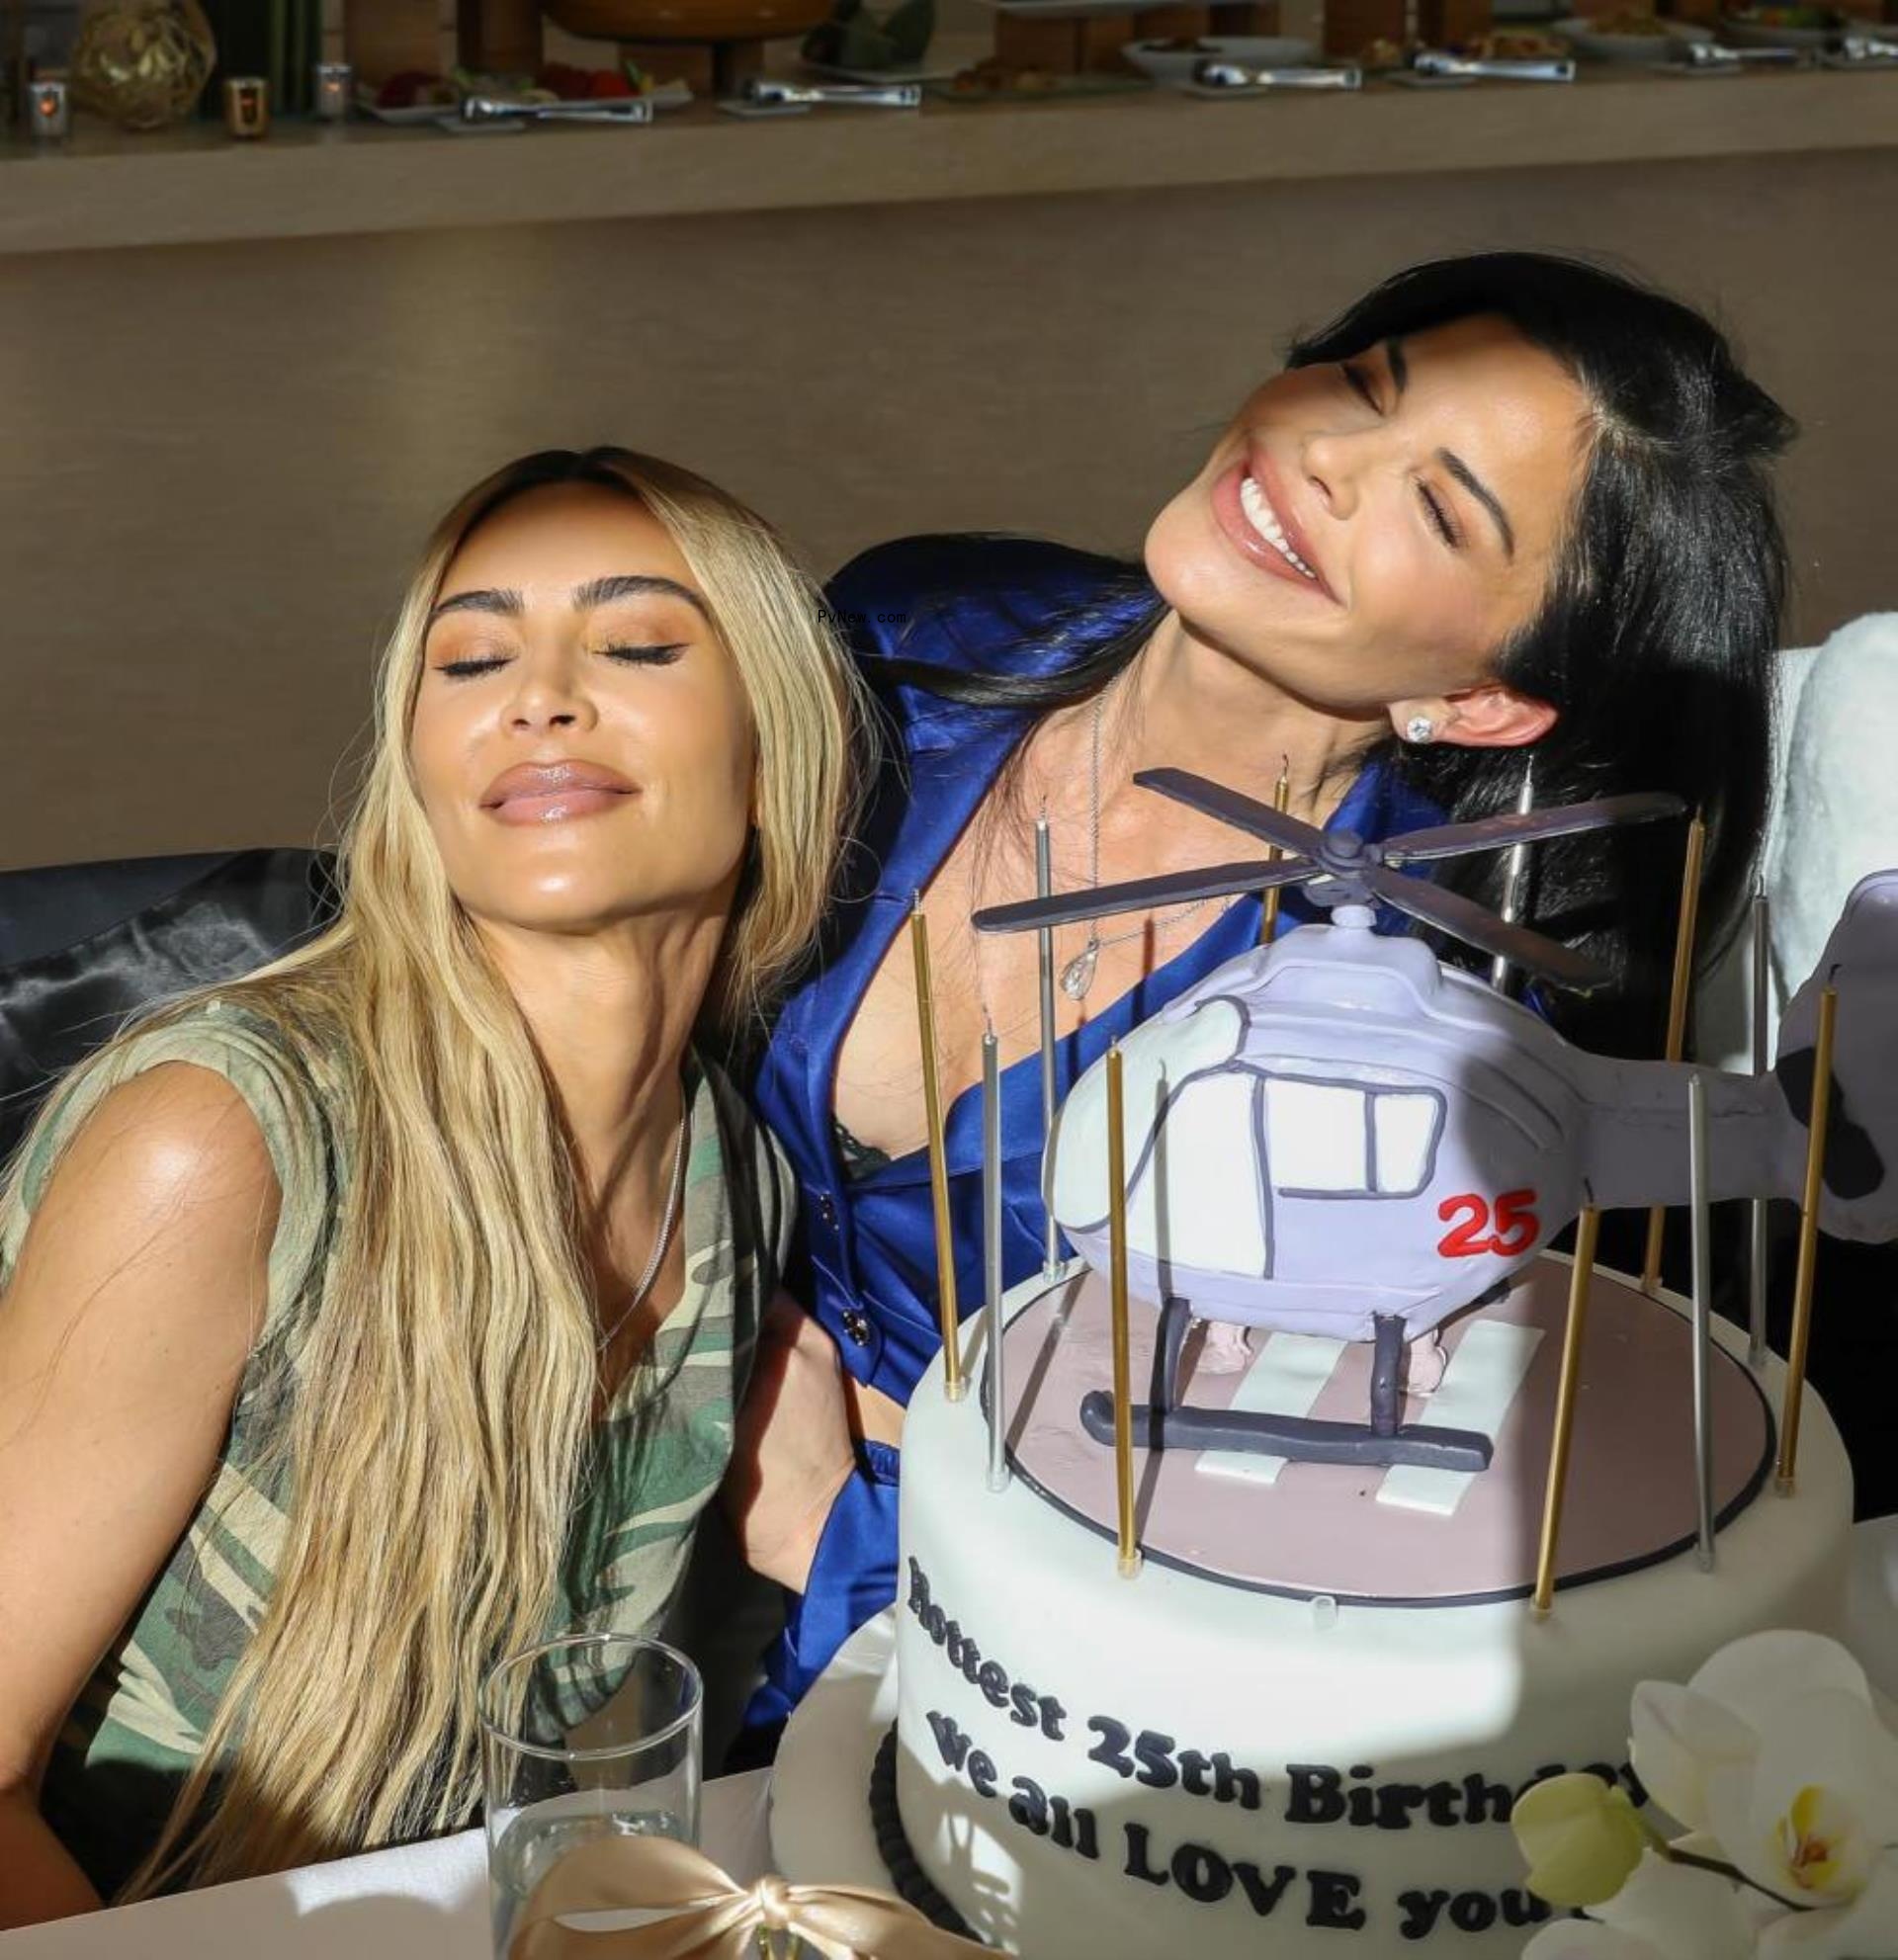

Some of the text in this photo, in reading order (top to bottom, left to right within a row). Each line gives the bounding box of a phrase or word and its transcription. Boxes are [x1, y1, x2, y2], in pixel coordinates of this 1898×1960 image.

[1437, 1188, 1540, 1257] 25
[907, 1556, 1650, 1830] hottest 25th Birth
[925, 1710, 998, 1799] We
[1007, 1776, 1100, 1860] all
[1123, 1822, 1367, 1931] LOVE
